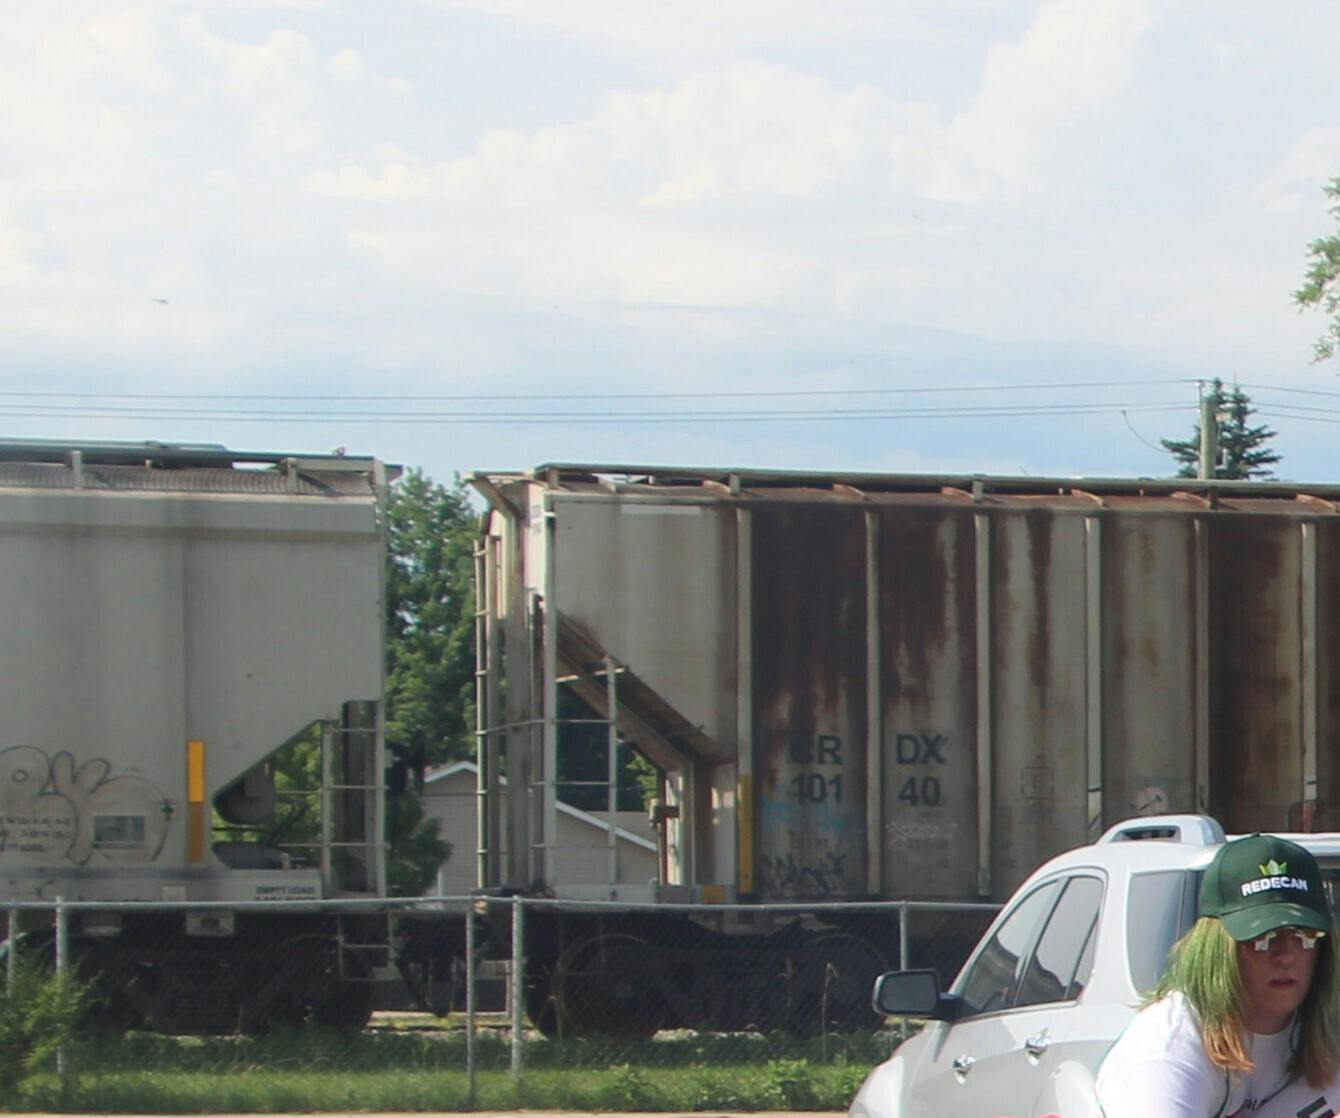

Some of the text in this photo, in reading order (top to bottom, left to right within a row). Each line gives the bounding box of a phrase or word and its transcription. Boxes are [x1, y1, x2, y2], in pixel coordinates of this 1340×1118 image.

[895, 734, 948, 765] DX
[899, 776, 941, 806] 40
[1240, 875, 1308, 897] REDECAN
